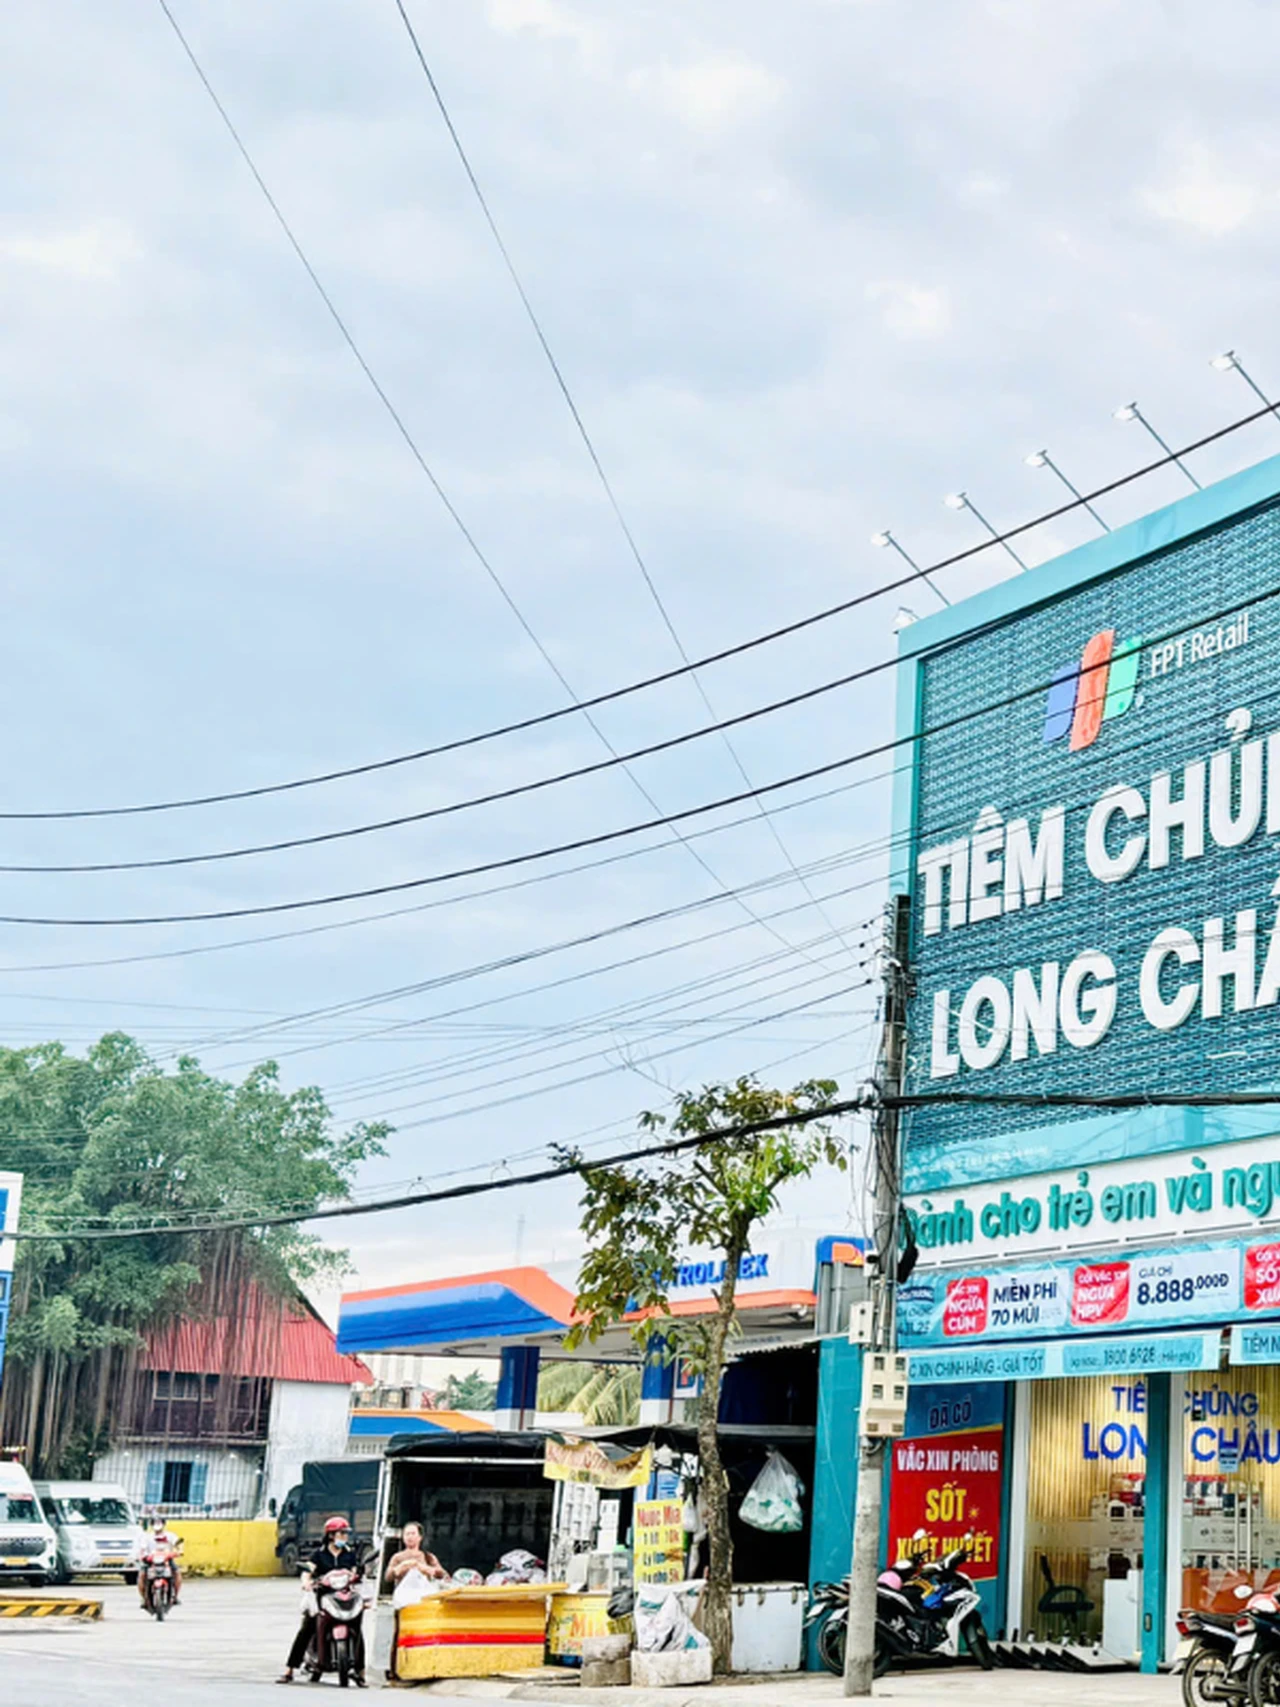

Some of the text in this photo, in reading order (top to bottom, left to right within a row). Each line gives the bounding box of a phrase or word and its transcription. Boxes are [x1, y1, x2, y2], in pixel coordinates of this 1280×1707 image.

[1150, 613, 1250, 679] FPT Retail
[917, 806, 1067, 936] TIÊM
[929, 949, 1117, 1079] LONG
[980, 1191, 1041, 1239] cho
[1047, 1171, 1094, 1232] trẻ
[1101, 1181, 1157, 1223] em
[1165, 1156, 1213, 1214] và
[993, 1277, 1058, 1303] MIỄN PHÍ
[948, 1314, 977, 1332] CÚM
[991, 1308, 1010, 1326] 70
[1013, 1303, 1040, 1325] MŨI
[1243, 1332, 1269, 1353] TIÊM
[929, 1394, 972, 1429] ĐÃ CÓ
[1111, 1381, 1146, 1413] TIÊ
[896, 1442, 999, 1472] VẮC XIN PHÒNG
[1082, 1422, 1147, 1461] LON
[925, 1480, 967, 1522] SỐT
